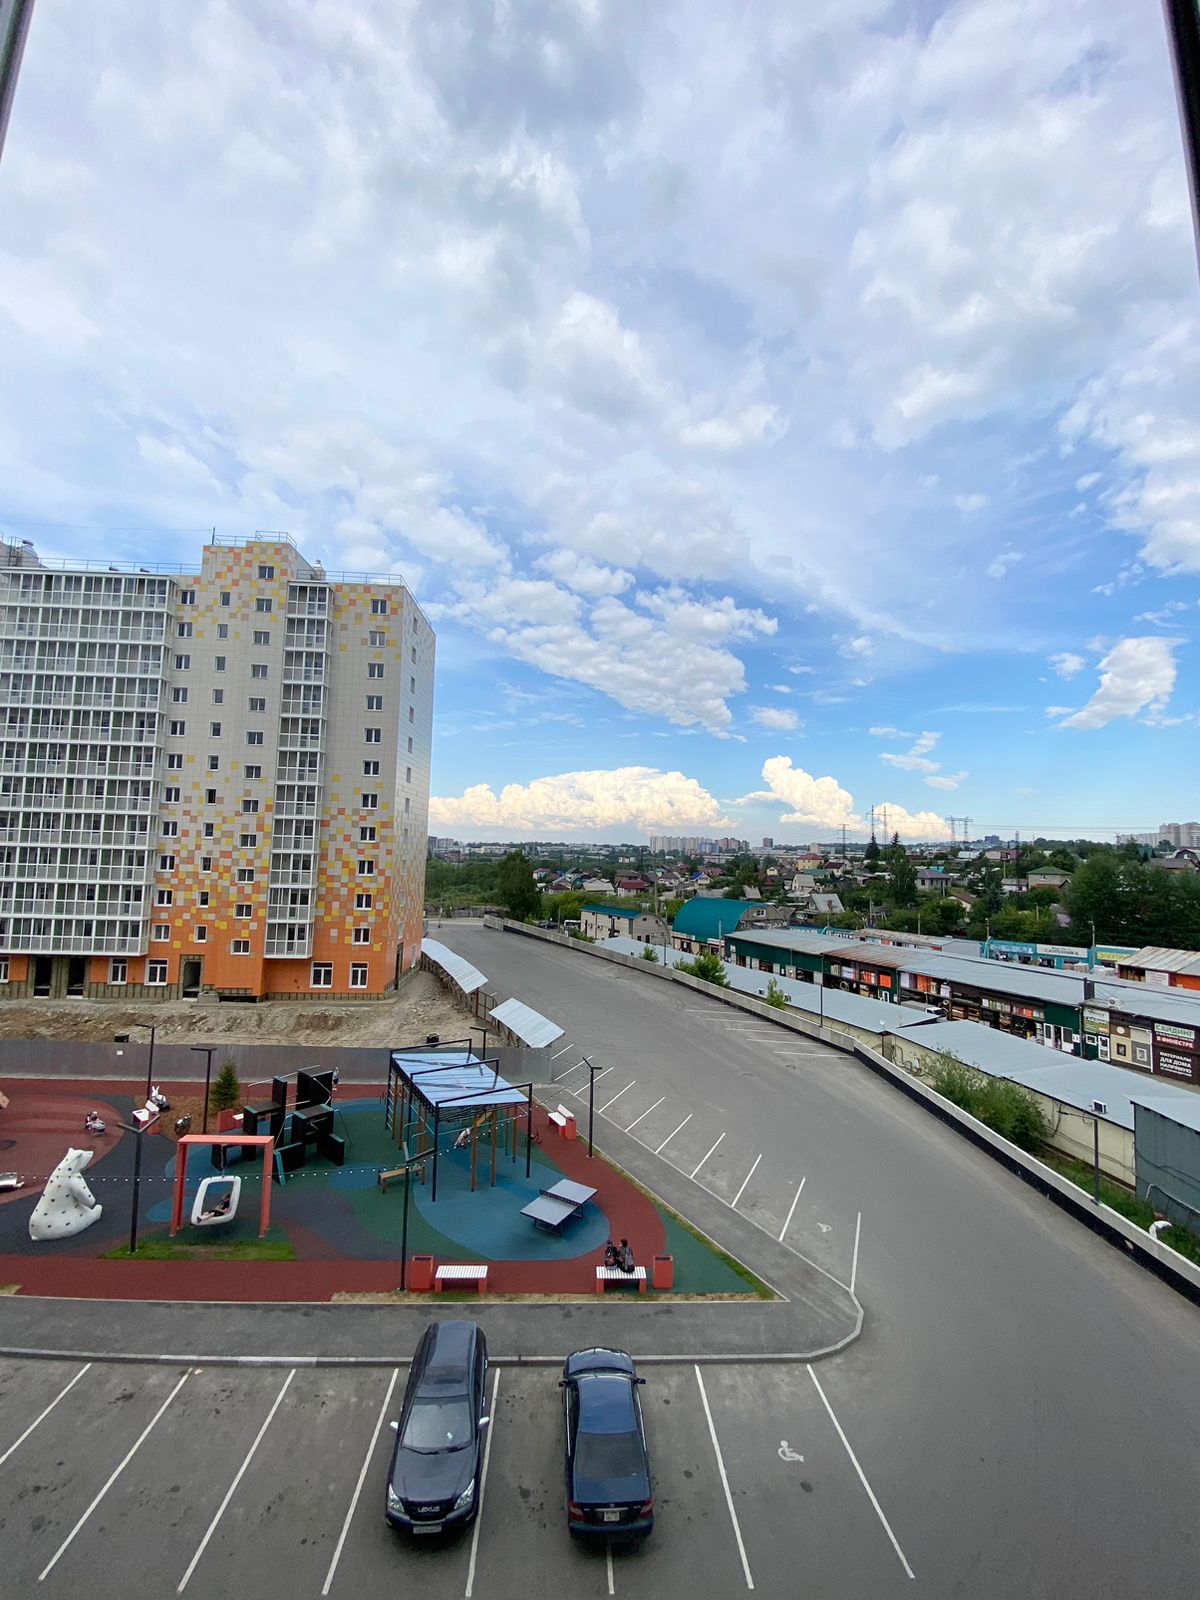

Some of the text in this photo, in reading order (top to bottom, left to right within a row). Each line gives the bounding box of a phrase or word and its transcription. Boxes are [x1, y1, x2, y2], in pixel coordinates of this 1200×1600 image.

[1155, 1024, 1193, 1038] САЙДИНГ
[1161, 1037, 1194, 1048] ФИНЕСТРЕ
[1159, 1051, 1192, 1063] МАТЕРИАЛЫ
[1160, 1056, 1192, 1069] ДЛЯ ДОМА
[417, 1505, 440, 1513] LEXUS
